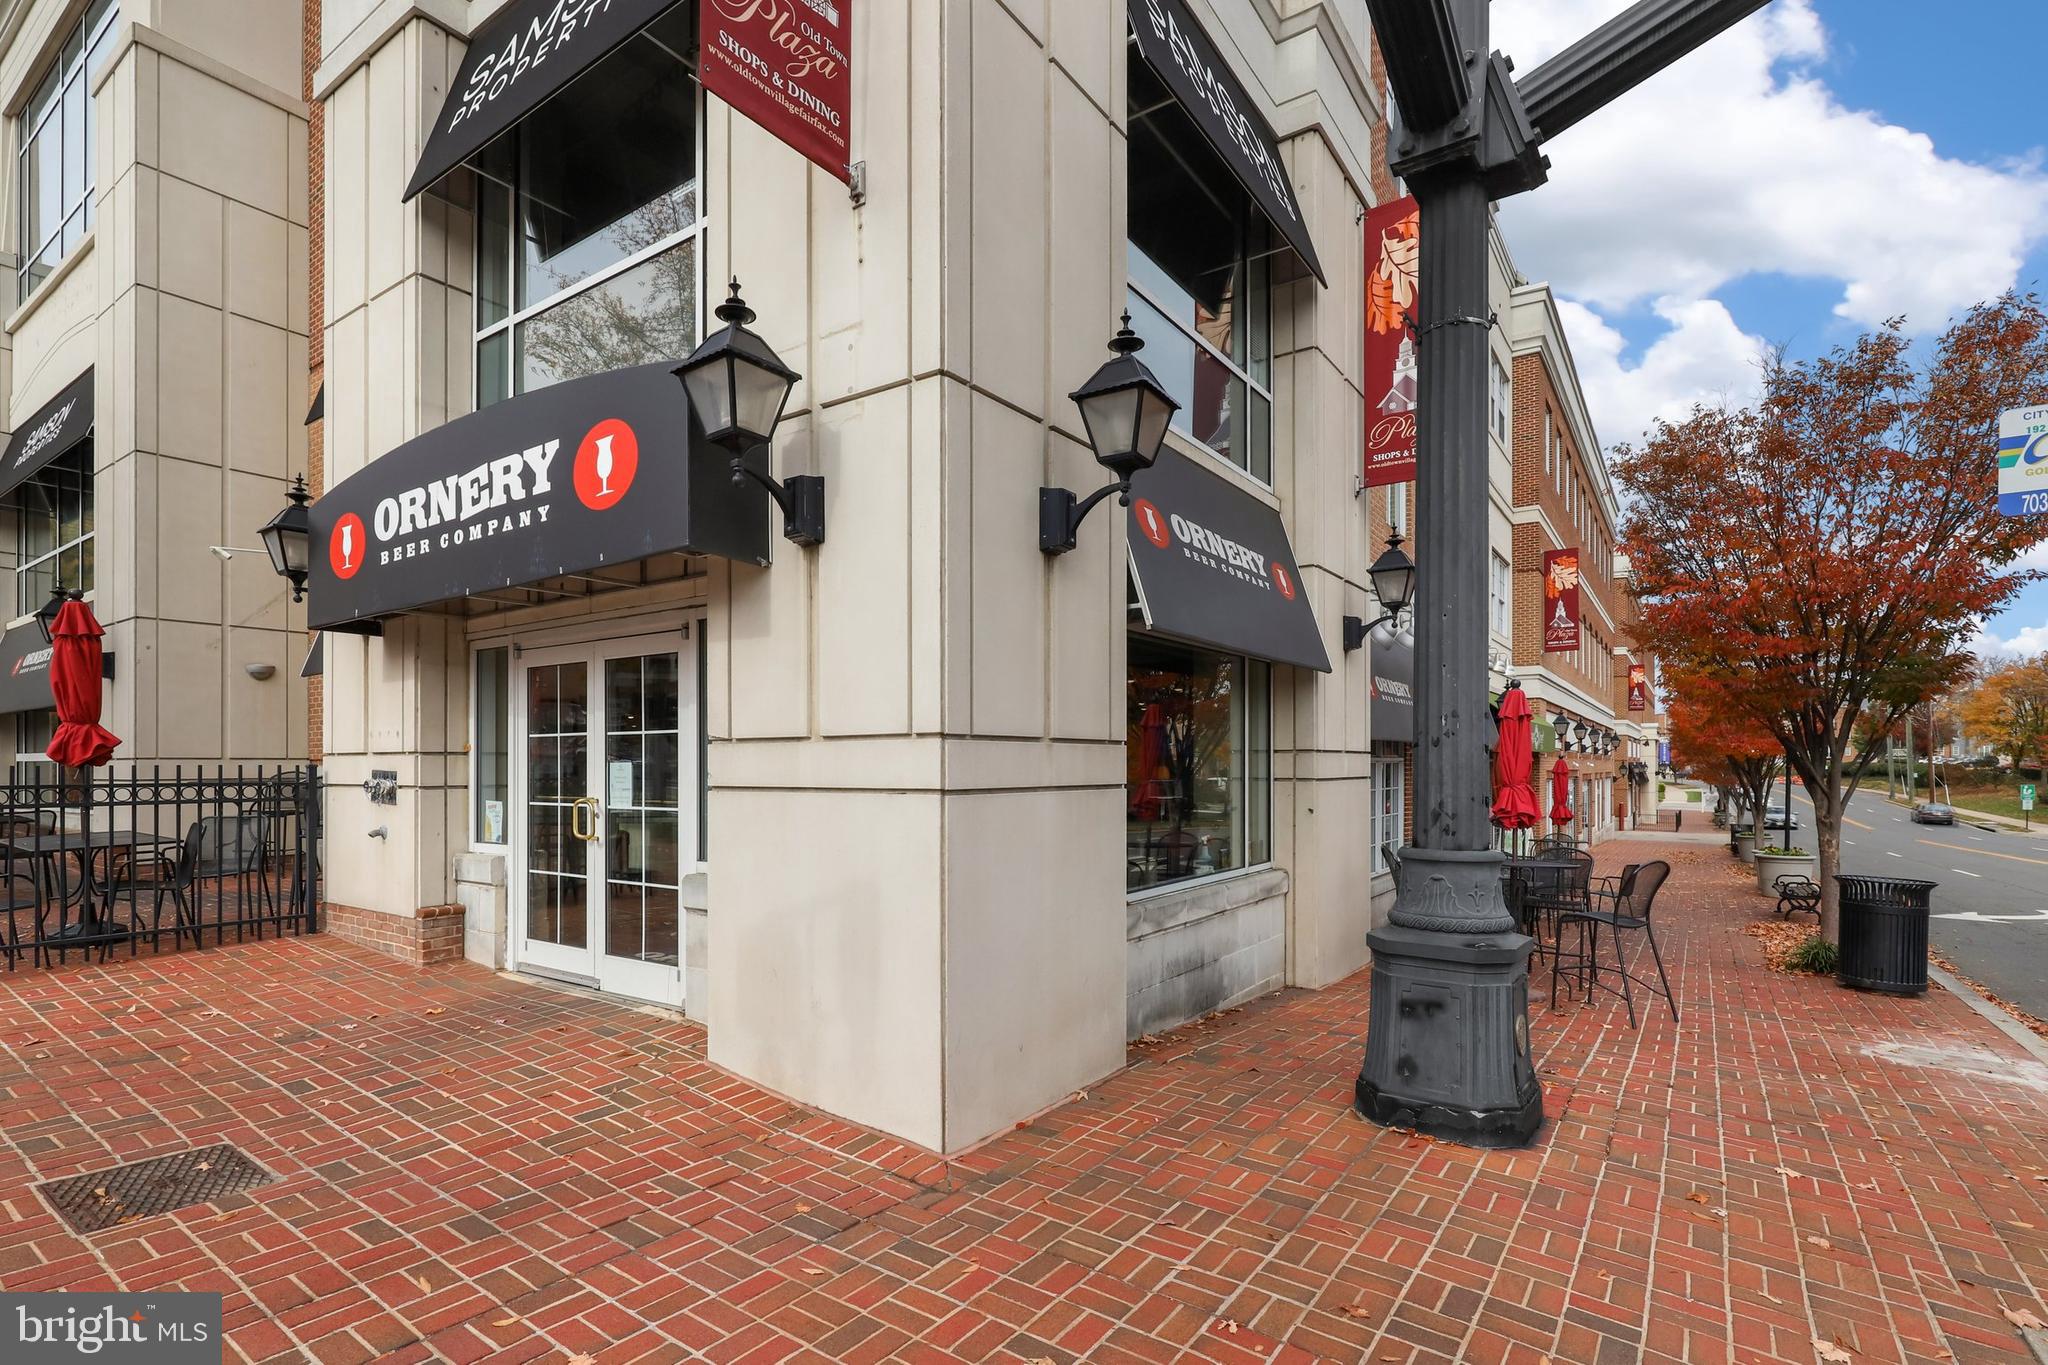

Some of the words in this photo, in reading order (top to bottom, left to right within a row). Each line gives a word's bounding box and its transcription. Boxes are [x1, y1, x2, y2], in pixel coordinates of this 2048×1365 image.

[801, 22, 821, 45] Old
[824, 36, 848, 68] Town
[708, 44, 845, 148] www.oldtownvillagefairfax.com
[719, 29, 768, 77] SHOPS
[772, 71, 784, 89] &
[788, 80, 841, 127] DINING
[1148, 10, 1296, 221] PROPERTIES
[22, 398, 76, 454] SAMSON
[1369, 414, 1416, 449] Pla
[1373, 450, 1401, 461] SHOPS
[1403, 449, 1409, 457] &
[374, 438, 560, 542] ORNERY
[2022, 492, 2048, 512] 703
[380, 539, 430, 566] BEER
[440, 505, 550, 549] COMPANY
[1170, 513, 1268, 577] ORNERY
[1183, 547, 1217, 569] BEER
[1221, 563, 1270, 590] COMPANY
[1374, 675, 1411, 698] ORNERY
